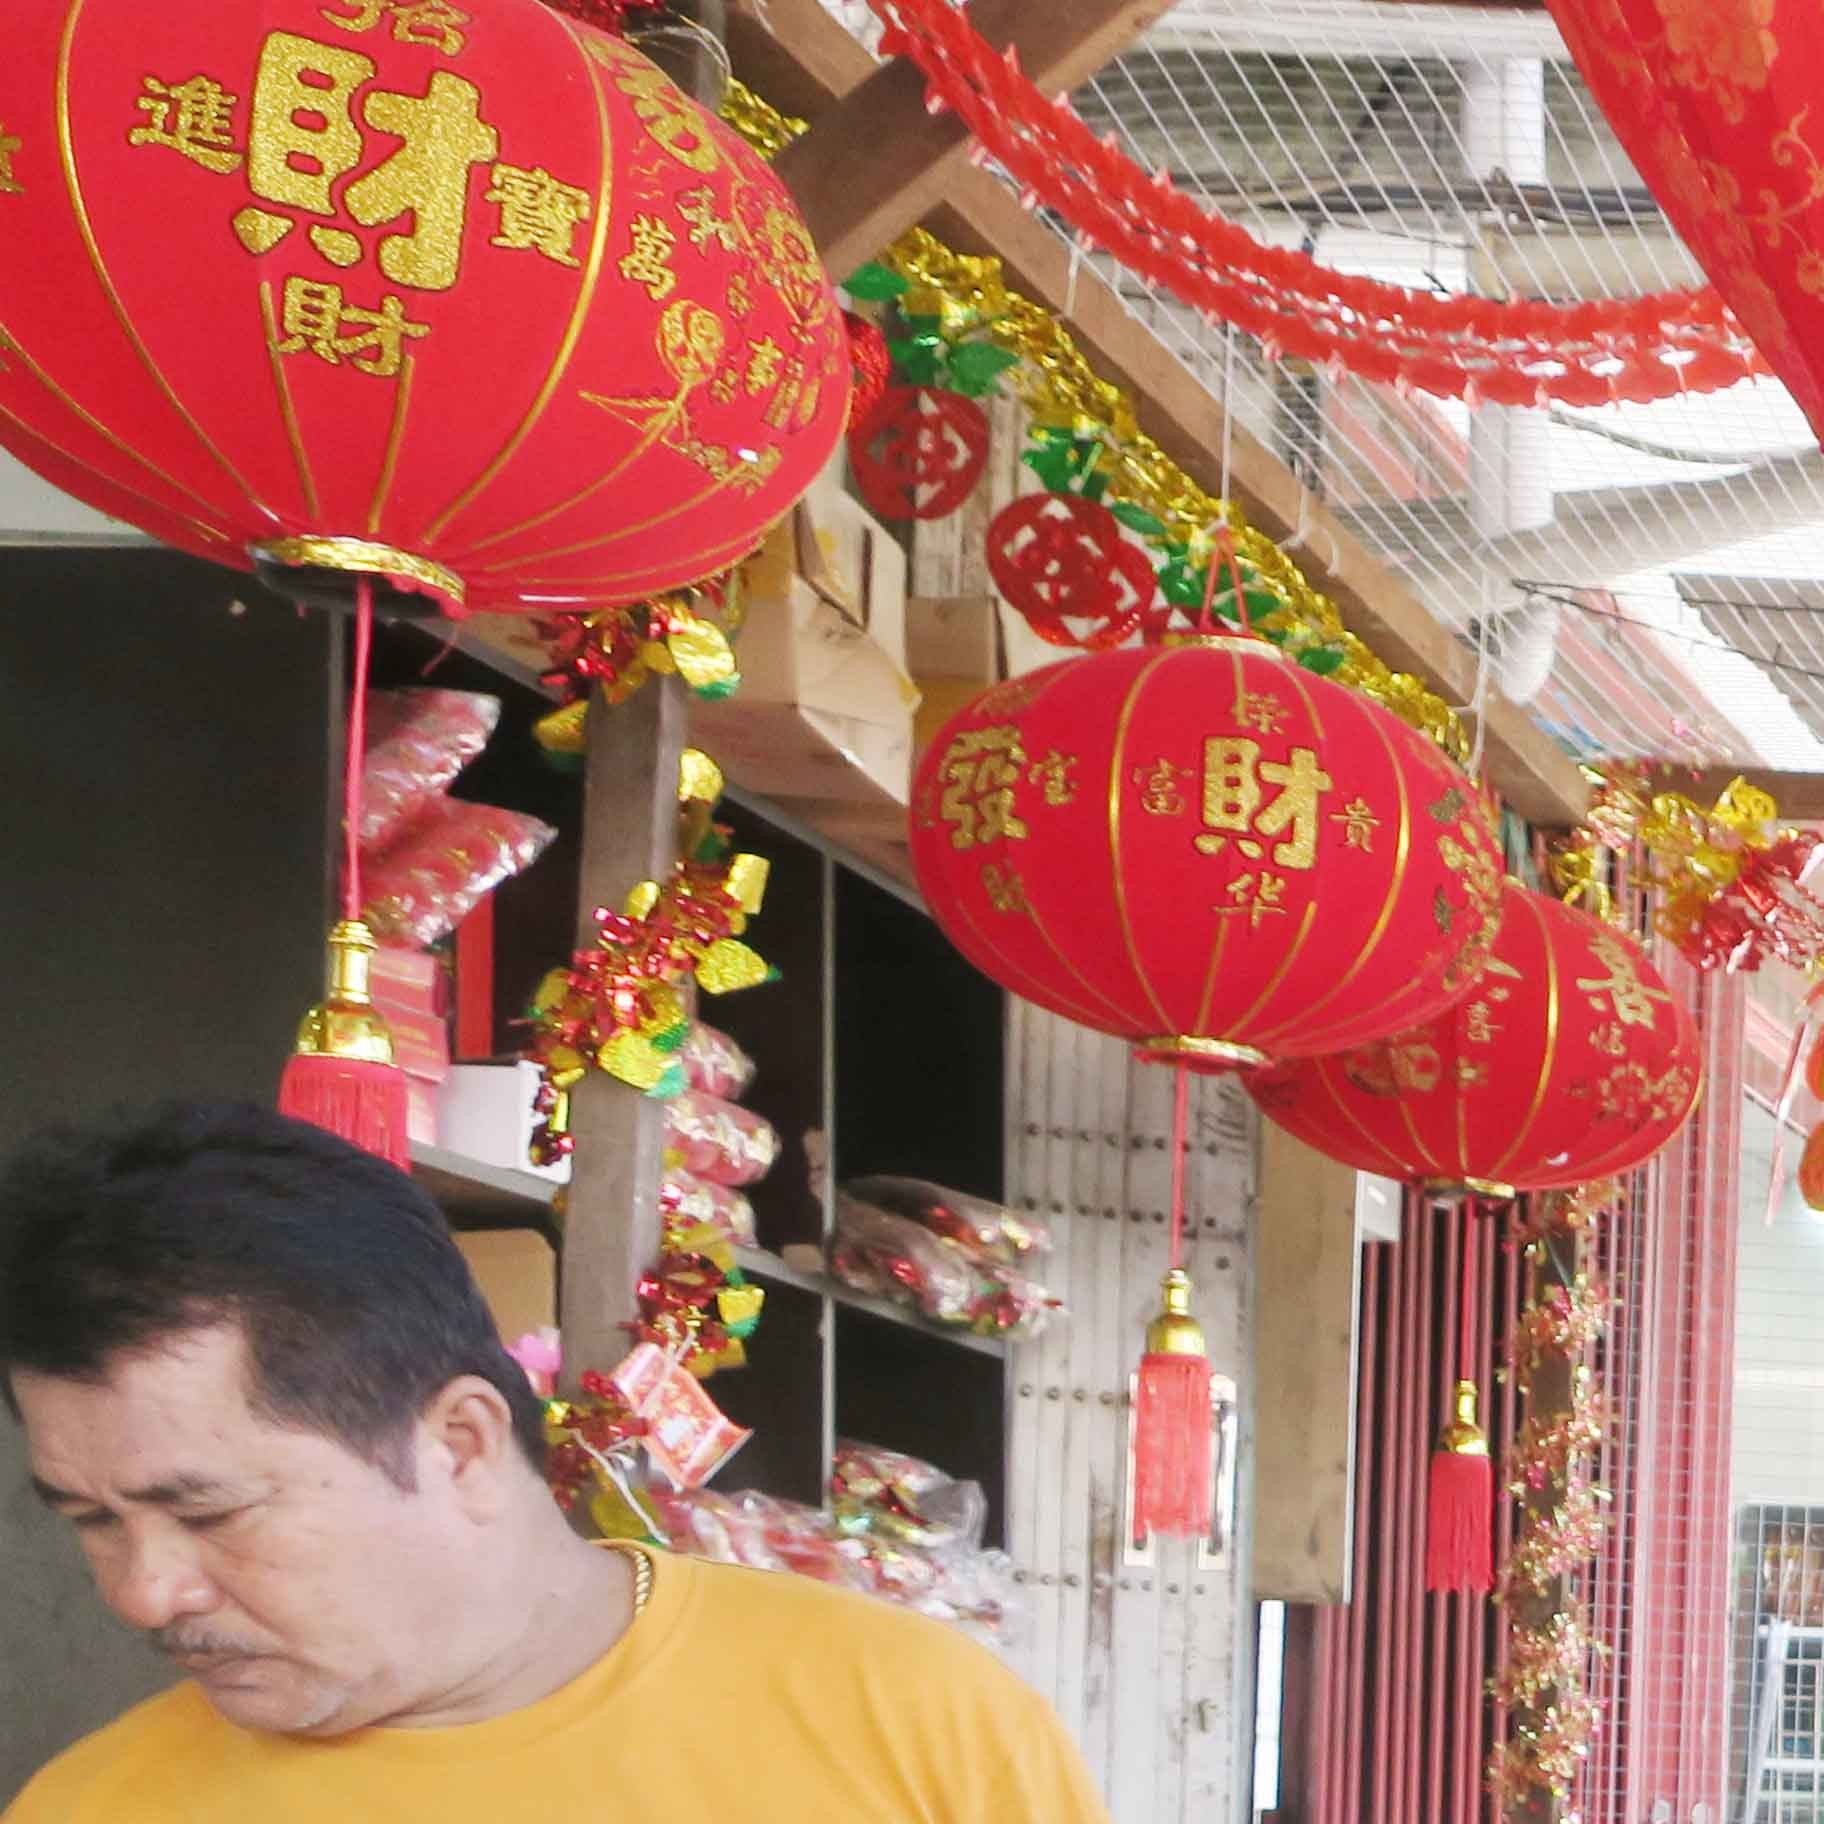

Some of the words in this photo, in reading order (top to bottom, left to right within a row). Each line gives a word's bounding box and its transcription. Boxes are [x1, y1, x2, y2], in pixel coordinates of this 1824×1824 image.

[128, 75, 243, 176] 進
[232, 29, 499, 291] 財
[485, 160, 592, 269] 寶
[278, 276, 430, 378] 財
[1192, 735, 1335, 871] 財
[1210, 869, 1288, 930] 华
